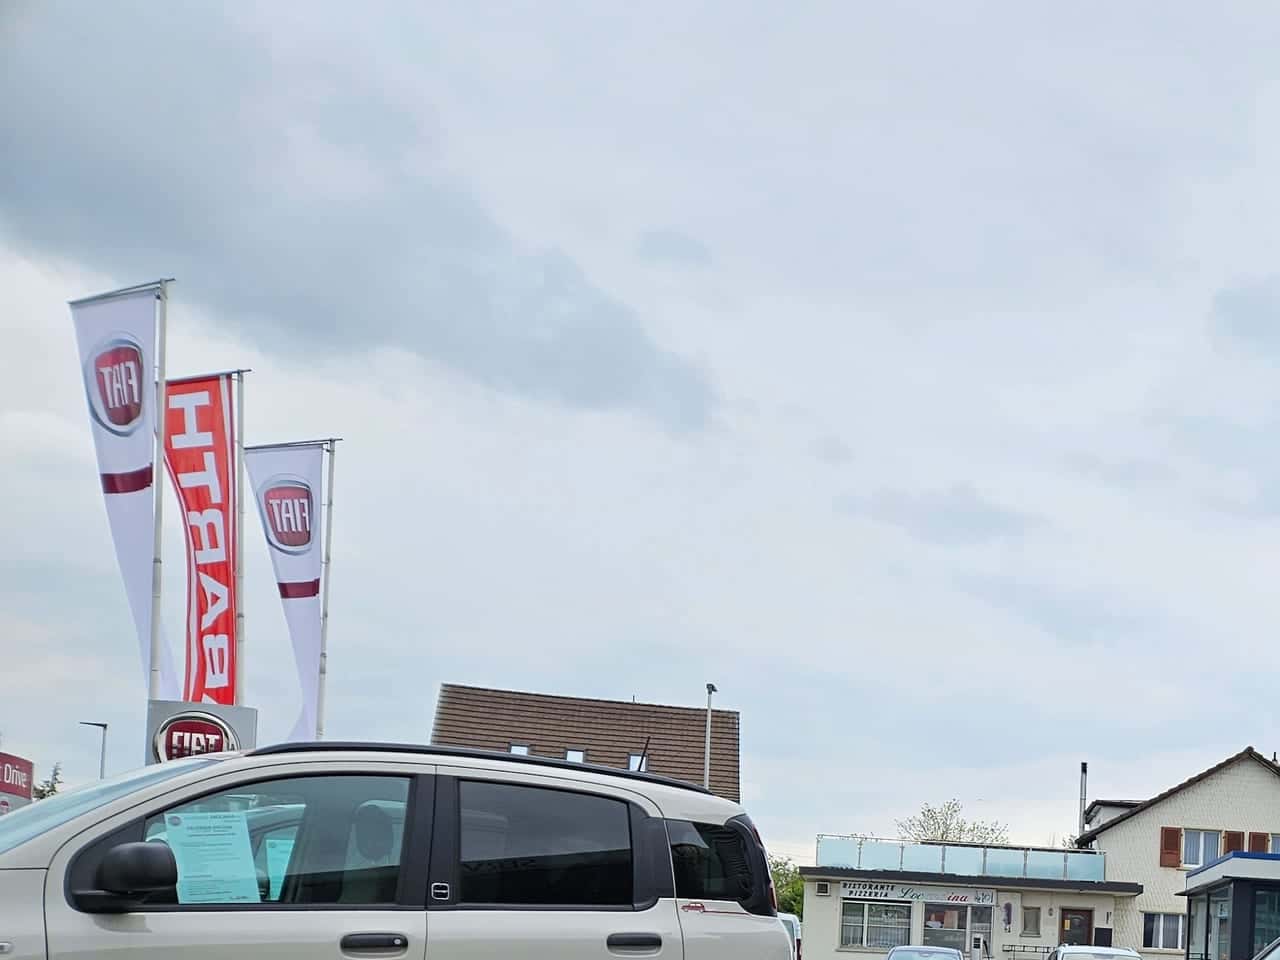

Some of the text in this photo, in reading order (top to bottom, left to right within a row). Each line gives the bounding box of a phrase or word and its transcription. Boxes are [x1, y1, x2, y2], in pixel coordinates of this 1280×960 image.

[172, 731, 220, 757] FIAT
[4, 763, 27, 788] Drive
[842, 882, 896, 891] RISTORANTE
[848, 890, 889, 898] PIZZERIA
